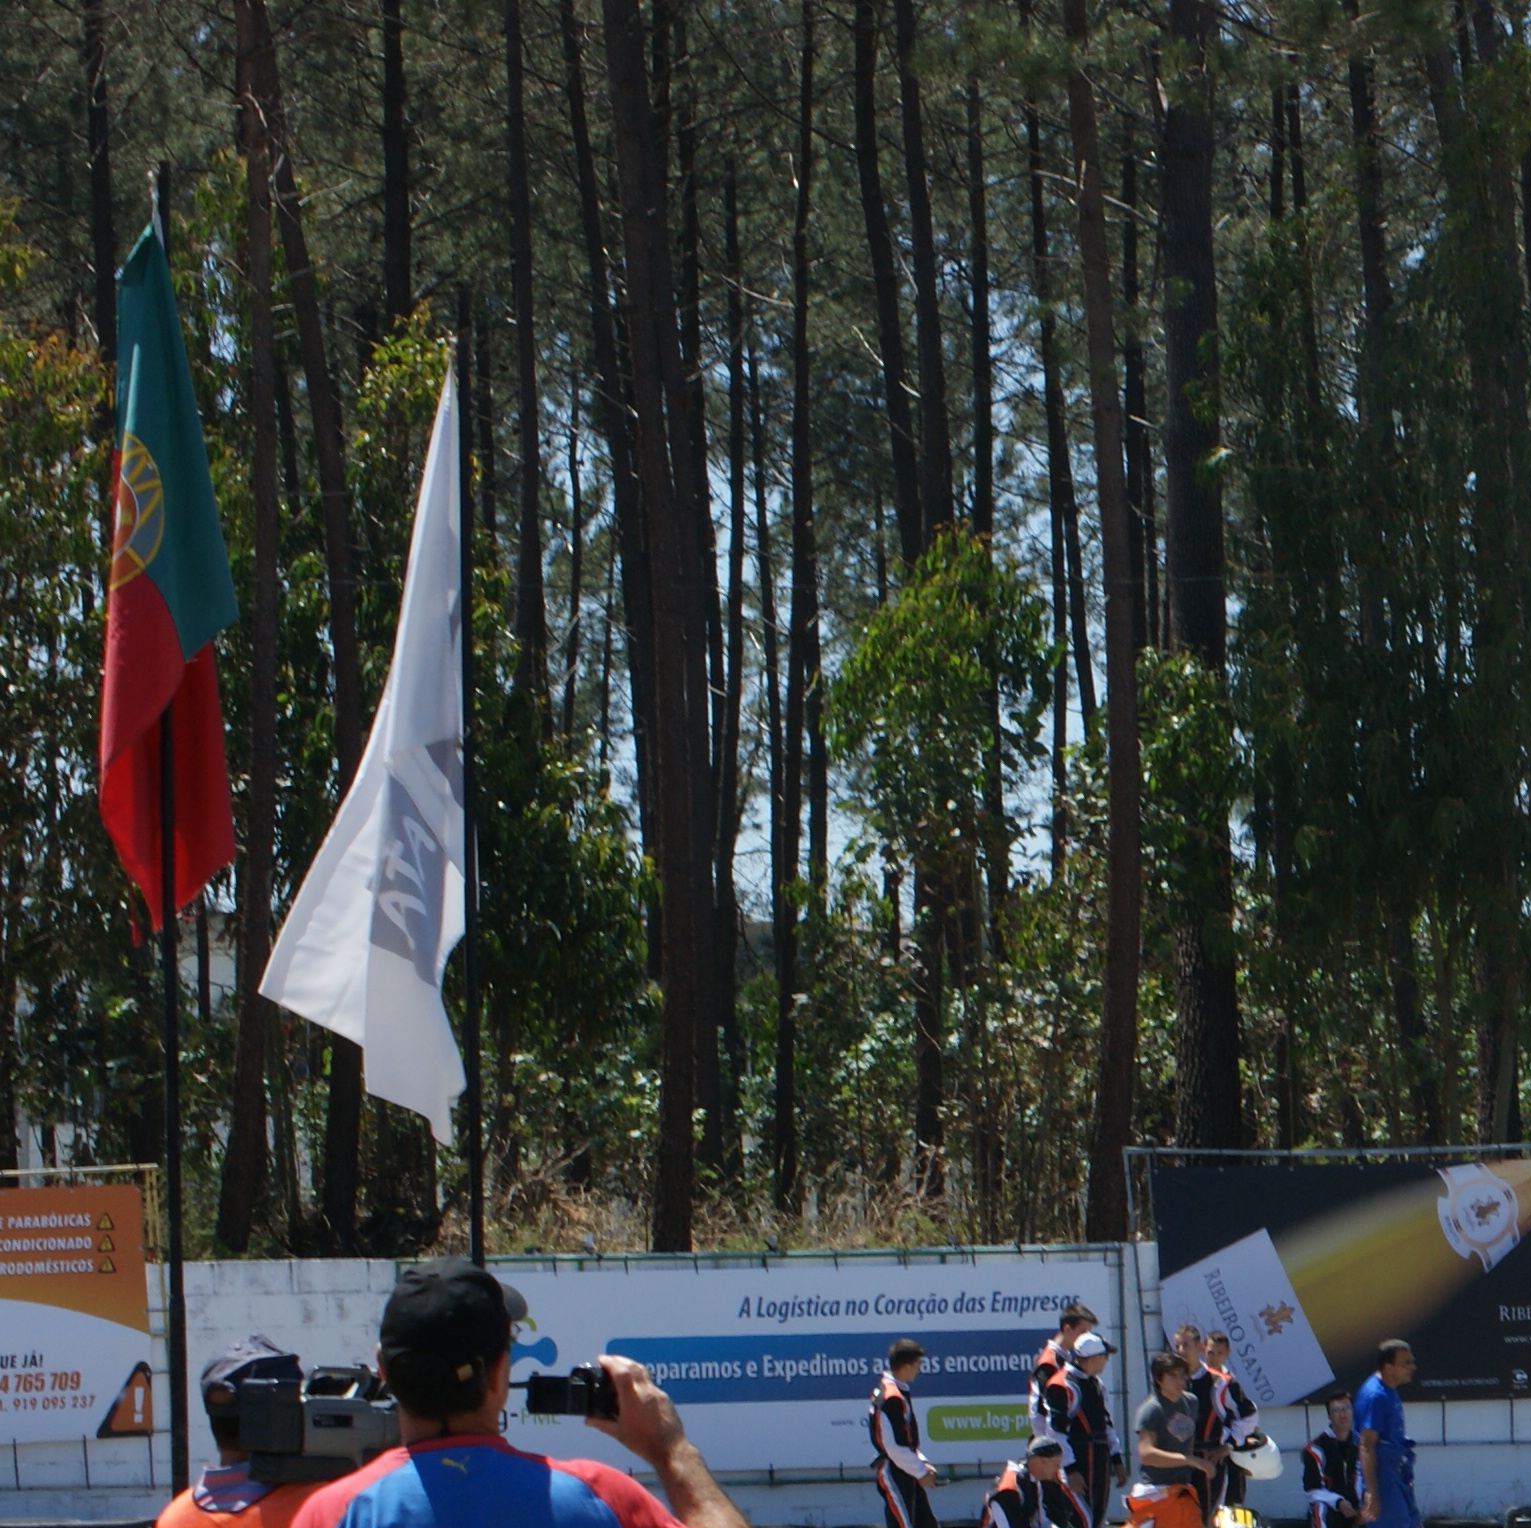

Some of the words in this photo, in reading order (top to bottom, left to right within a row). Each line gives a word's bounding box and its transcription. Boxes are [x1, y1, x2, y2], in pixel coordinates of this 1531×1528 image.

[7, 1212, 92, 1230] PARABÓLICAS
[738, 1297, 751, 1319] A
[756, 1294, 840, 1324] Logística
[845, 1299, 869, 1317] no
[874, 1292, 949, 1320] Coração
[952, 1290, 986, 1313] das
[1203, 1268, 1246, 1342] RIBEIRO
[1236, 1343, 1276, 1402] SANTO
[650, 1361, 742, 1384] eparamos
[746, 1363, 757, 1378] e
[762, 1353, 869, 1383] Expedimos
[944, 1349, 1034, 1373] encomen
[14, 1371, 46, 1393] 765
[50, 1370, 82, 1392] 709
[12, 1397, 38, 1411] 919
